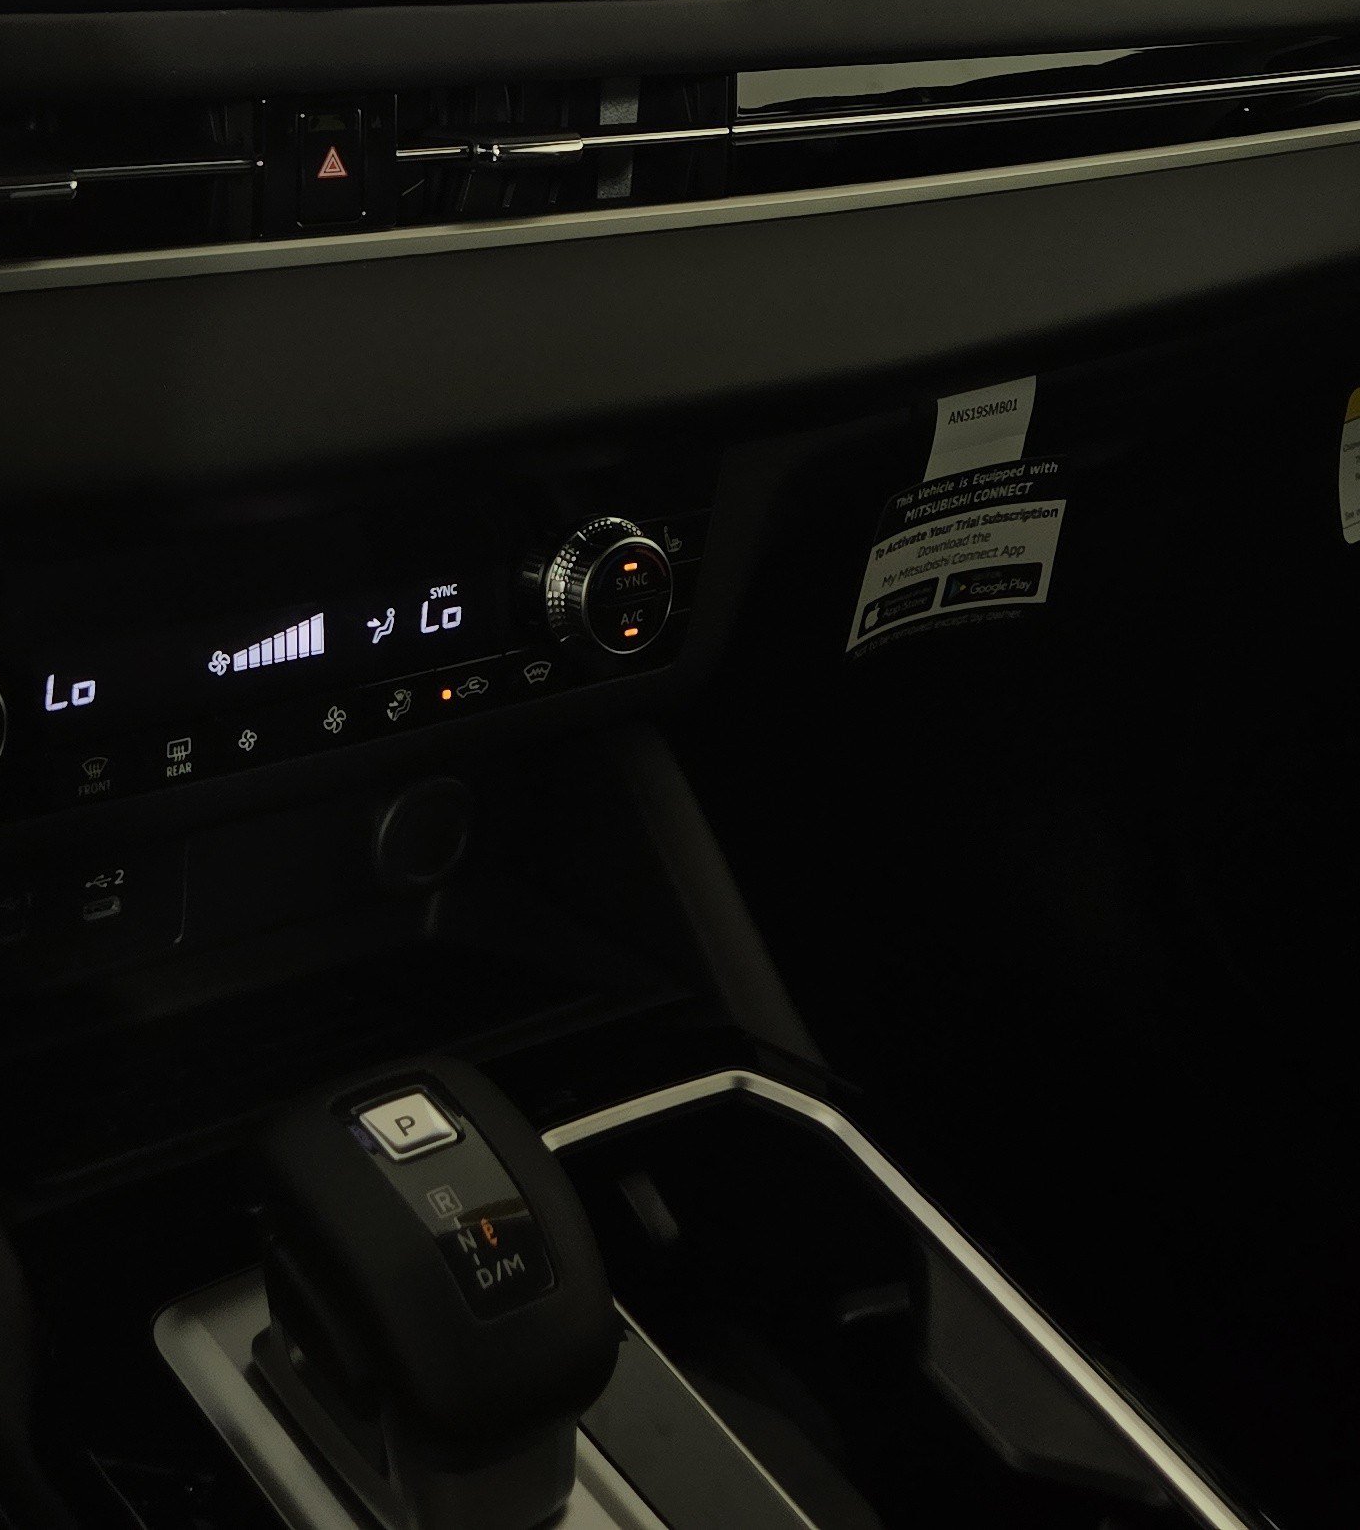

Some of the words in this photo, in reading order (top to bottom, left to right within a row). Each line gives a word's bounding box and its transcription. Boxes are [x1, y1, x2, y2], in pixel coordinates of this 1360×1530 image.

[896, 496, 912, 510] This
[918, 482, 954, 500] Vehicle
[959, 477, 968, 489] is
[973, 464, 1024, 485] Equipped
[1030, 462, 1058, 476] with
[905, 492, 971, 523] MITSUBISHI
[973, 482, 1033, 503] CONNECT
[886, 530, 927, 553] Activate
[930, 524, 952, 539] Your
[955, 516, 979, 532] Trial
[981, 506, 1058, 526] Subscription
[916, 534, 970, 559] Download
[972, 532, 991, 545] the
[881, 573, 898, 589] My
[898, 555, 949, 581] Mitsubishi
[951, 548, 998, 566] Connect
[1002, 545, 1025, 558] App
[430, 583, 458, 600] SYNC
[615, 572, 649, 591] SYNC
[970, 579, 1006, 596] Google
[1008, 578, 1032, 592] Play
[420, 600, 462, 634] Lo
[620, 609, 644, 626] A/C
[45, 674, 96, 711] Lo
[167, 762, 192, 778] REAR
[78, 779, 111, 797] FRONT
[114, 869, 125, 885] 2
[395, 1115, 416, 1138] P
[438, 1193, 455, 1213] R
[457, 1230, 478, 1253] N
[476, 1253, 526, 1290] D/M
